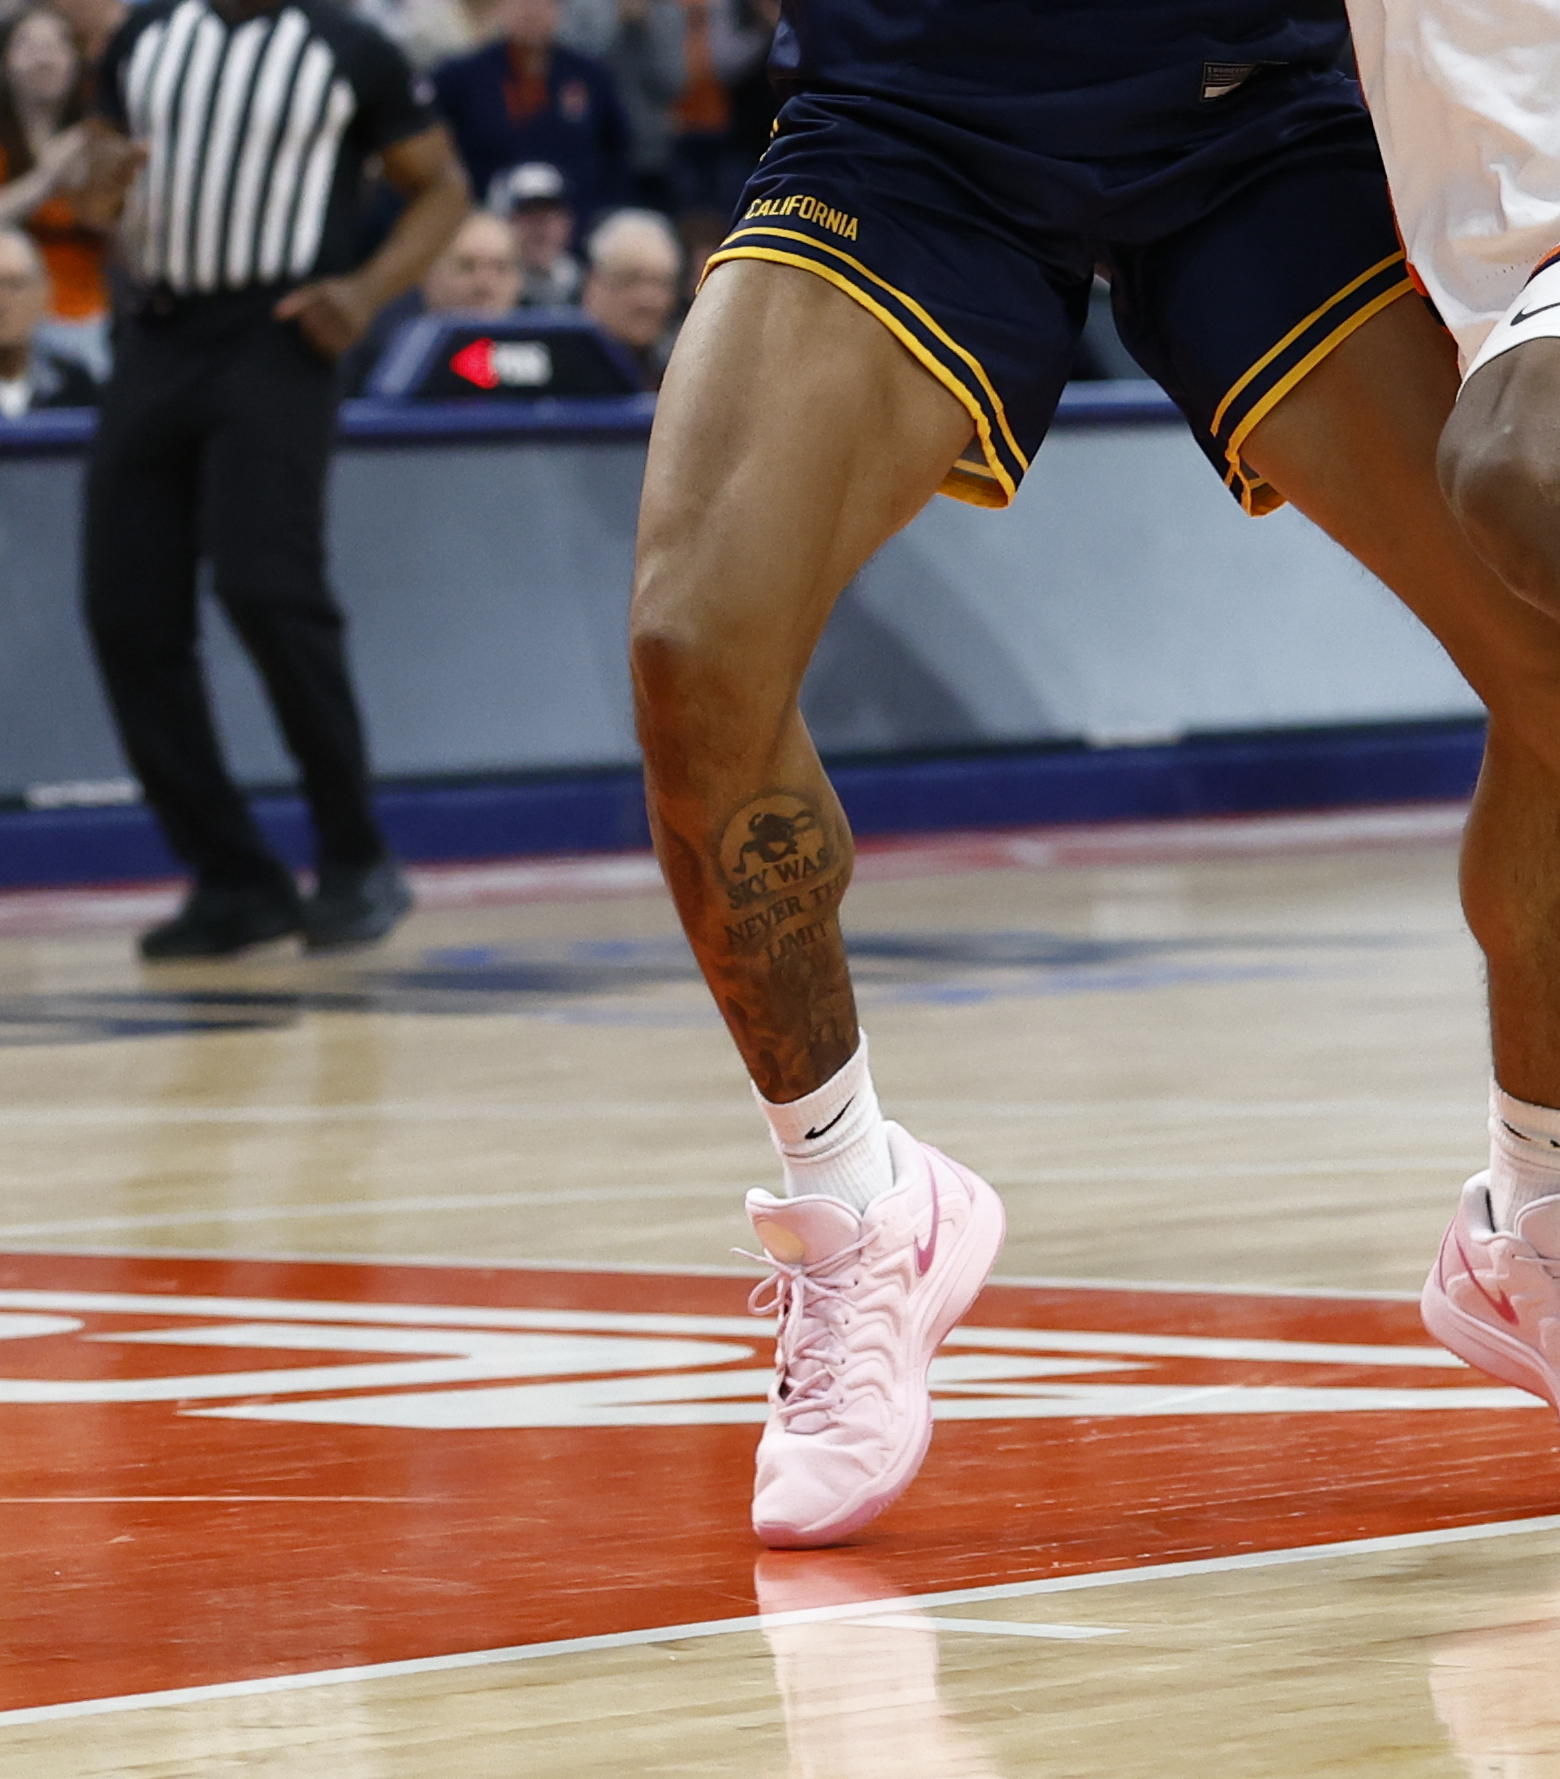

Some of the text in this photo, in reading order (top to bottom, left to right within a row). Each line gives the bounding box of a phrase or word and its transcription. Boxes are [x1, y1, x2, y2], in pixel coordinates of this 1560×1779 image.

[744, 194, 860, 242] CALIFORNIA
[727, 868, 769, 910] SKY
[723, 895, 805, 947] NEVER
[765, 919, 827, 966] LIMIT
